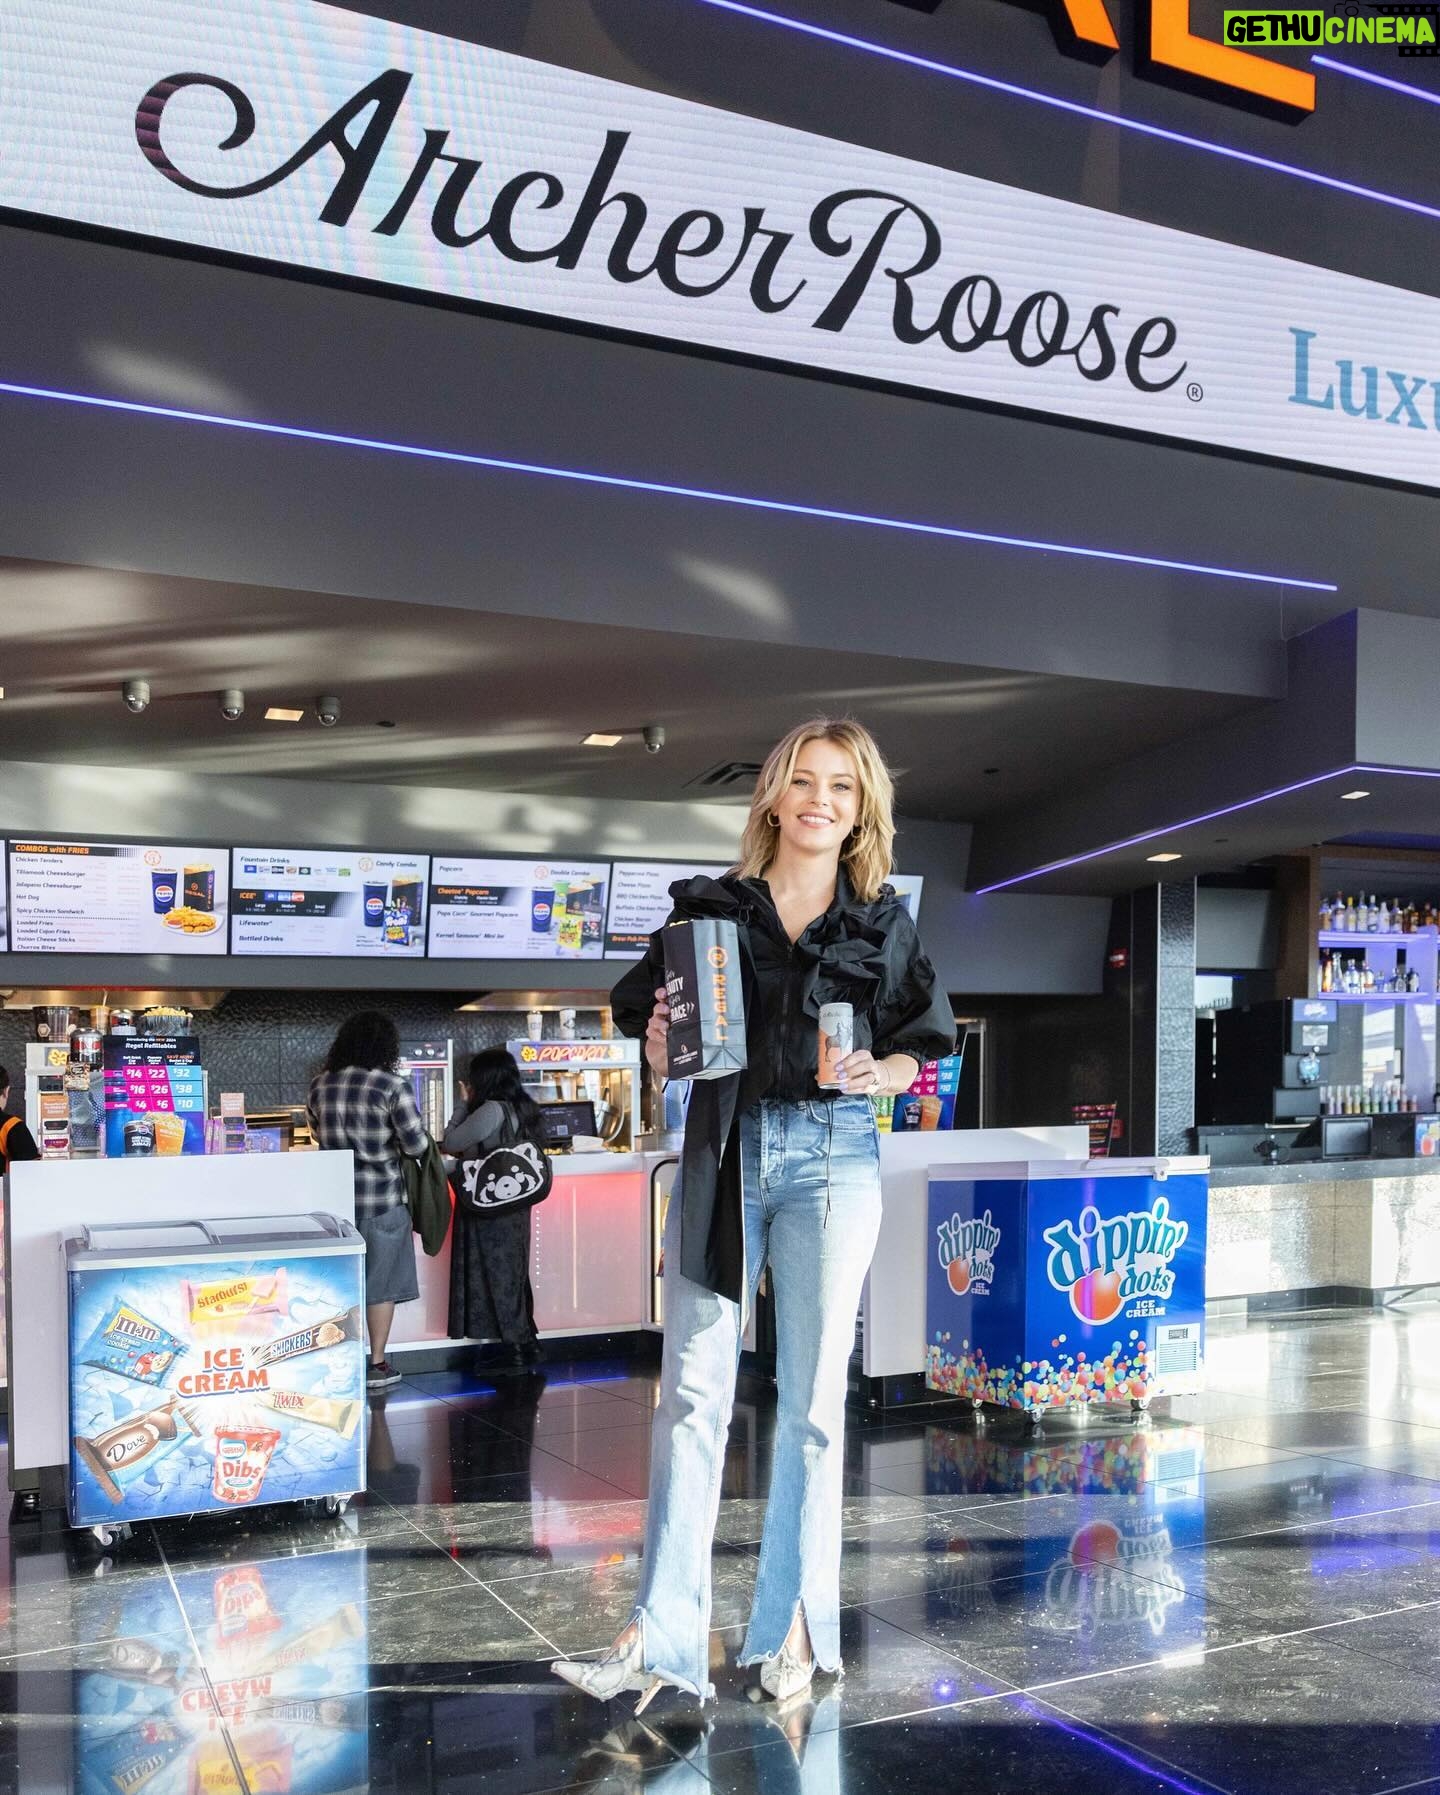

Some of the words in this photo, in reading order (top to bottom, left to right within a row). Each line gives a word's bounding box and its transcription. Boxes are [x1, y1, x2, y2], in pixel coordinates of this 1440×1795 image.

[135, 69, 807, 313] Archer
[15, 845, 48, 853] COMBOS
[712, 973, 729, 1040] REGAL
[125, 1042, 143, 1050] Regal
[538, 1046, 607, 1062] POPCORN
[127, 1069, 142, 1079] $14
[148, 1069, 166, 1079] $22
[173, 1068, 190, 1078] $32
[130, 1084, 146, 1094] $16
[151, 1085, 168, 1094] $26
[175, 1084, 193, 1094] $38
[136, 1100, 147, 1110] $4
[157, 1100, 168, 1109] $6
[178, 1099, 194, 1108] $10
[1046, 1200, 1186, 1289] dippin'
[969, 1257, 994, 1279] dots
[1119, 1264, 1173, 1298] dots
[198, 1282, 248, 1308] Starburst
[1136, 1300, 1156, 1309] ICE
[1125, 1307, 1166, 1318] CREAM
[272, 1331, 312, 1356] SNICKERS
[204, 1348, 243, 1369] ICE
[178, 1369, 269, 1394] CREAM
[223, 1460, 262, 1479] Dibs
